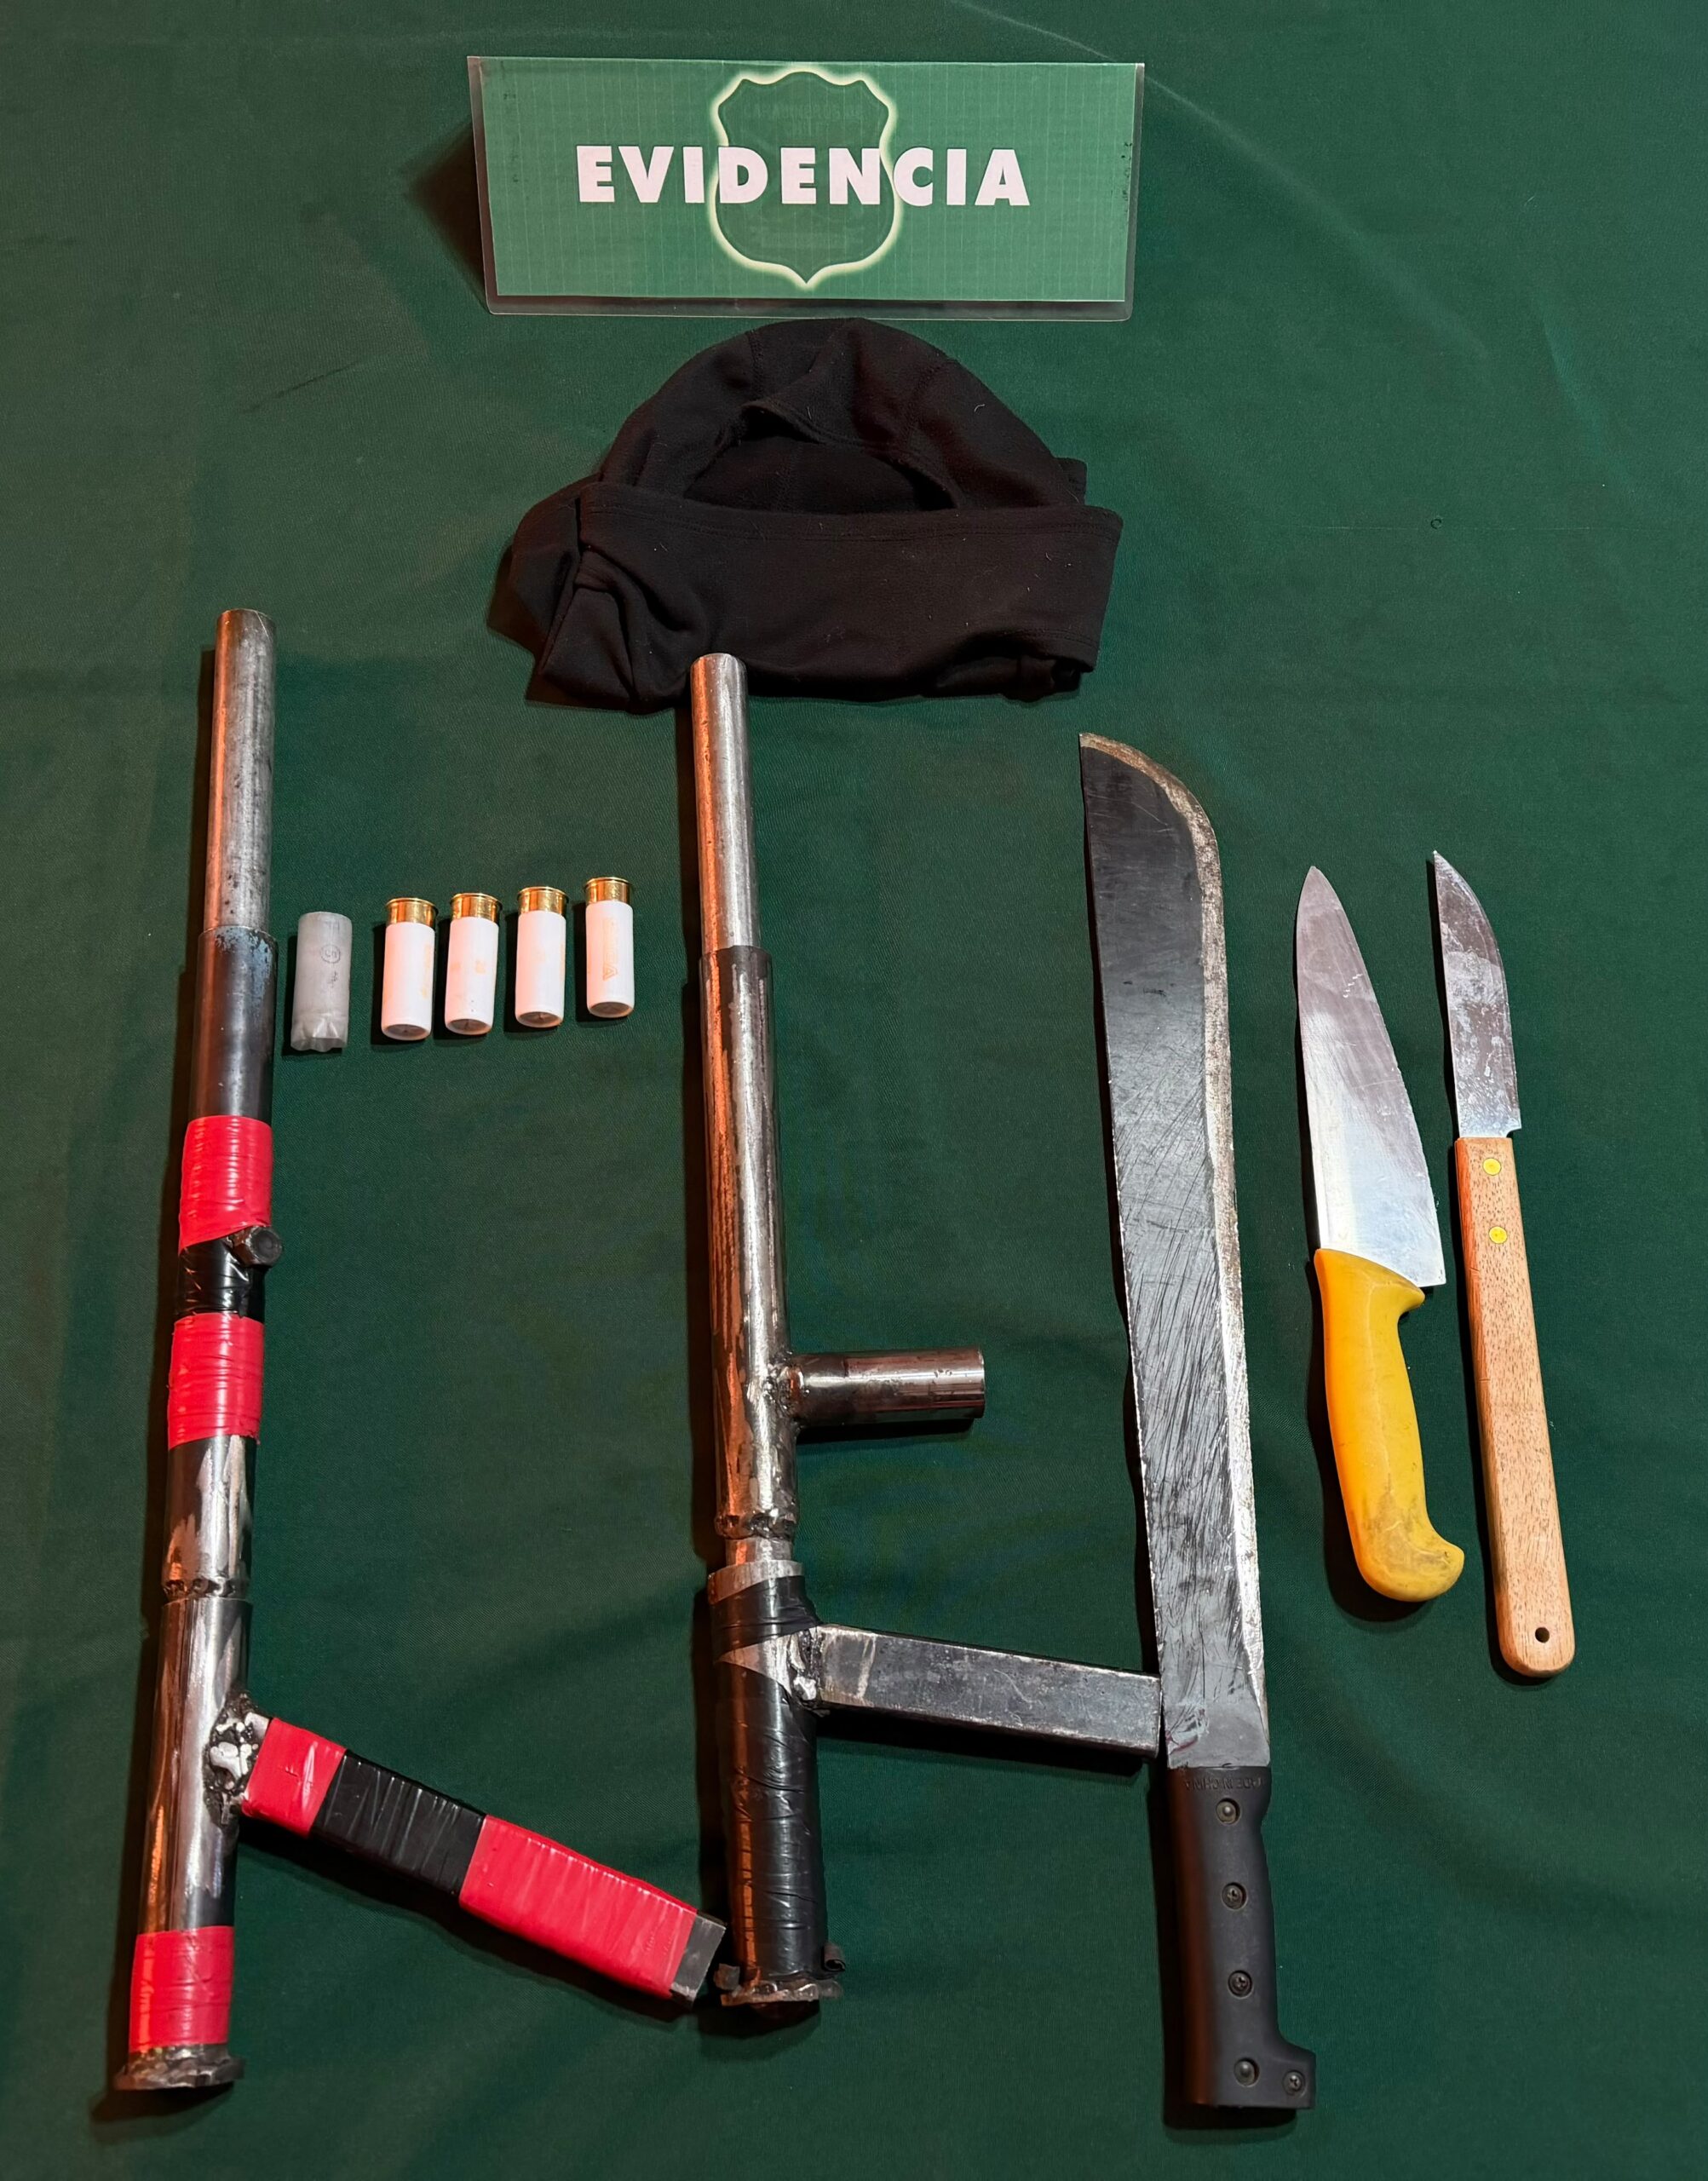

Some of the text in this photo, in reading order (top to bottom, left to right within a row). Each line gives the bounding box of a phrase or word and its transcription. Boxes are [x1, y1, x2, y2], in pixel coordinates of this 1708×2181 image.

[576, 145, 1031, 206] EVIDENCIA
[1185, 1777, 1222, 1792] CHINA
[1222, 1777, 1234, 1791] IN
